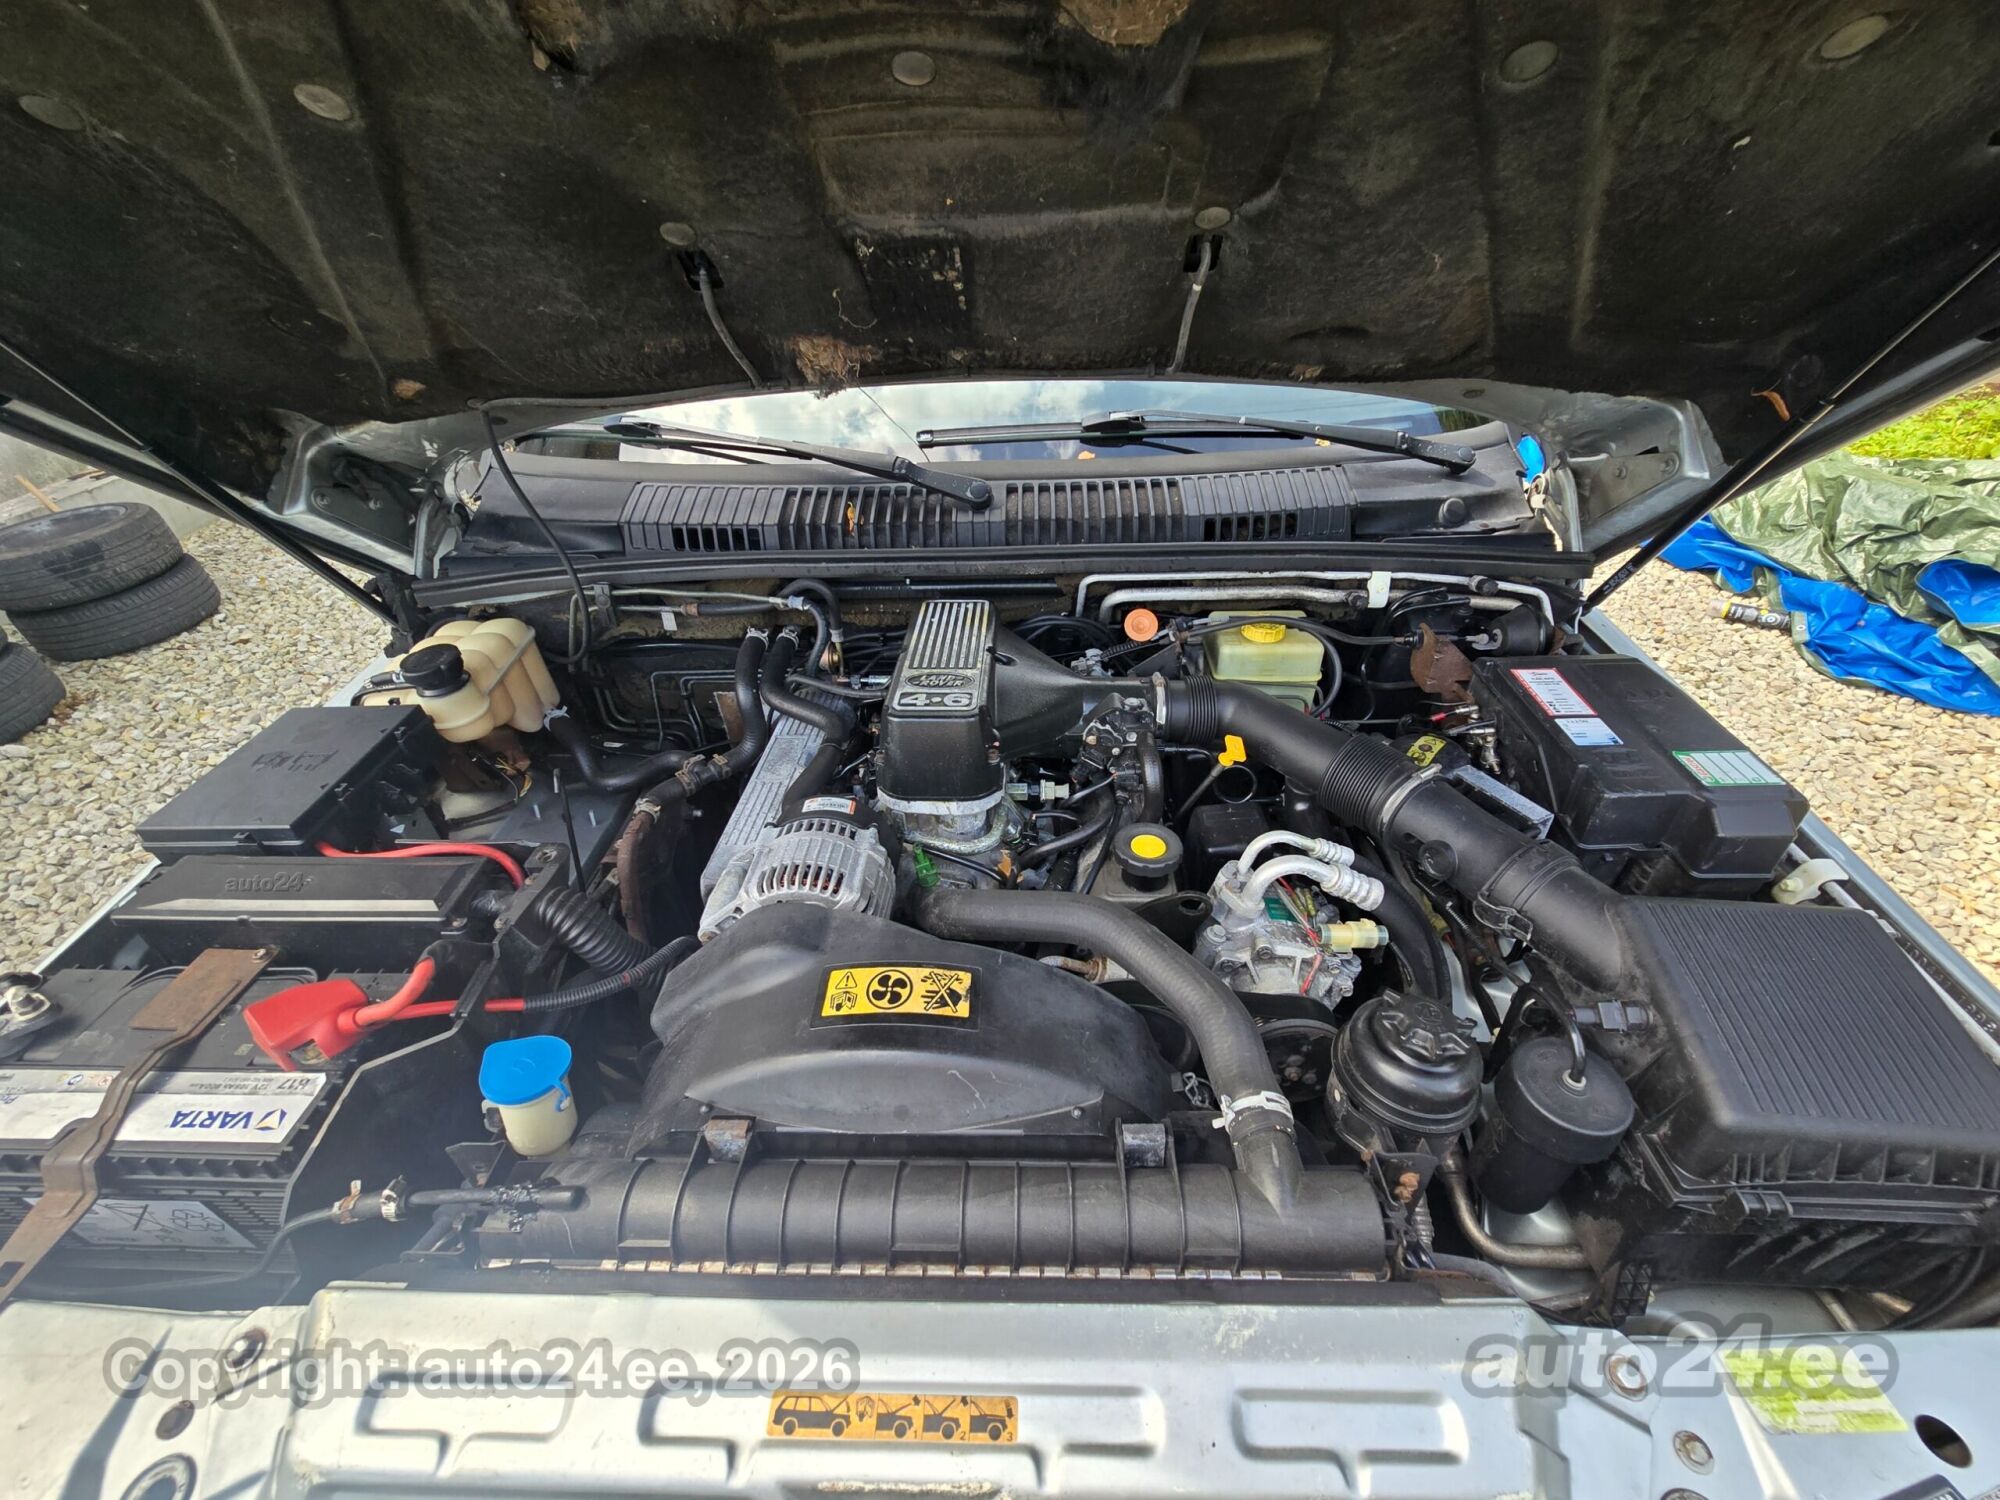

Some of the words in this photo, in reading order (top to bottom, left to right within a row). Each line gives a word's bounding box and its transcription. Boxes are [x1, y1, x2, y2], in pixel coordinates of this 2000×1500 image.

[169, 1110, 254, 1129] VARTA
[960, 1431, 967, 1441] 2
[1006, 1432, 1013, 1442] 3
